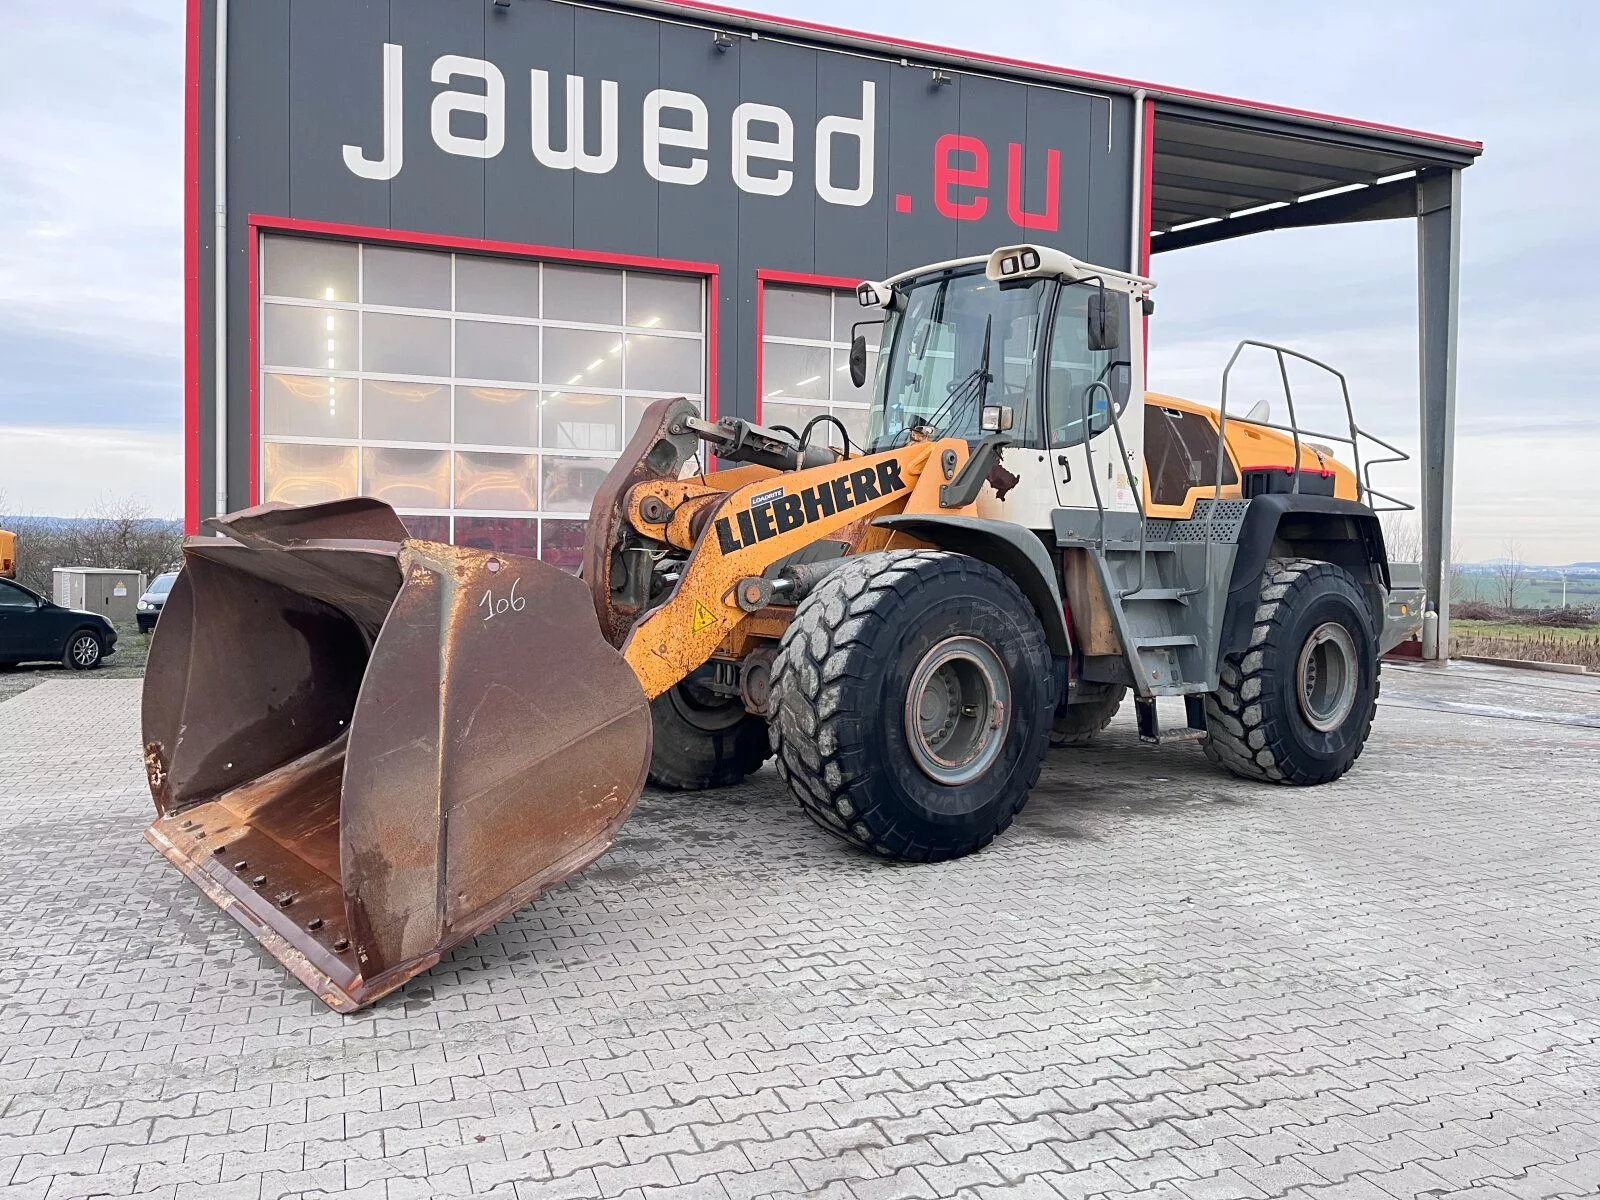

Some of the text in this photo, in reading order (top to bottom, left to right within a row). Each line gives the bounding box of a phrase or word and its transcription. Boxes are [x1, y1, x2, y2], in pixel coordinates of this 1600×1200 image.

[715, 459, 906, 555] LIEBHERR
[752, 490, 782, 504] LOADRITE
[479, 577, 526, 621] 106
